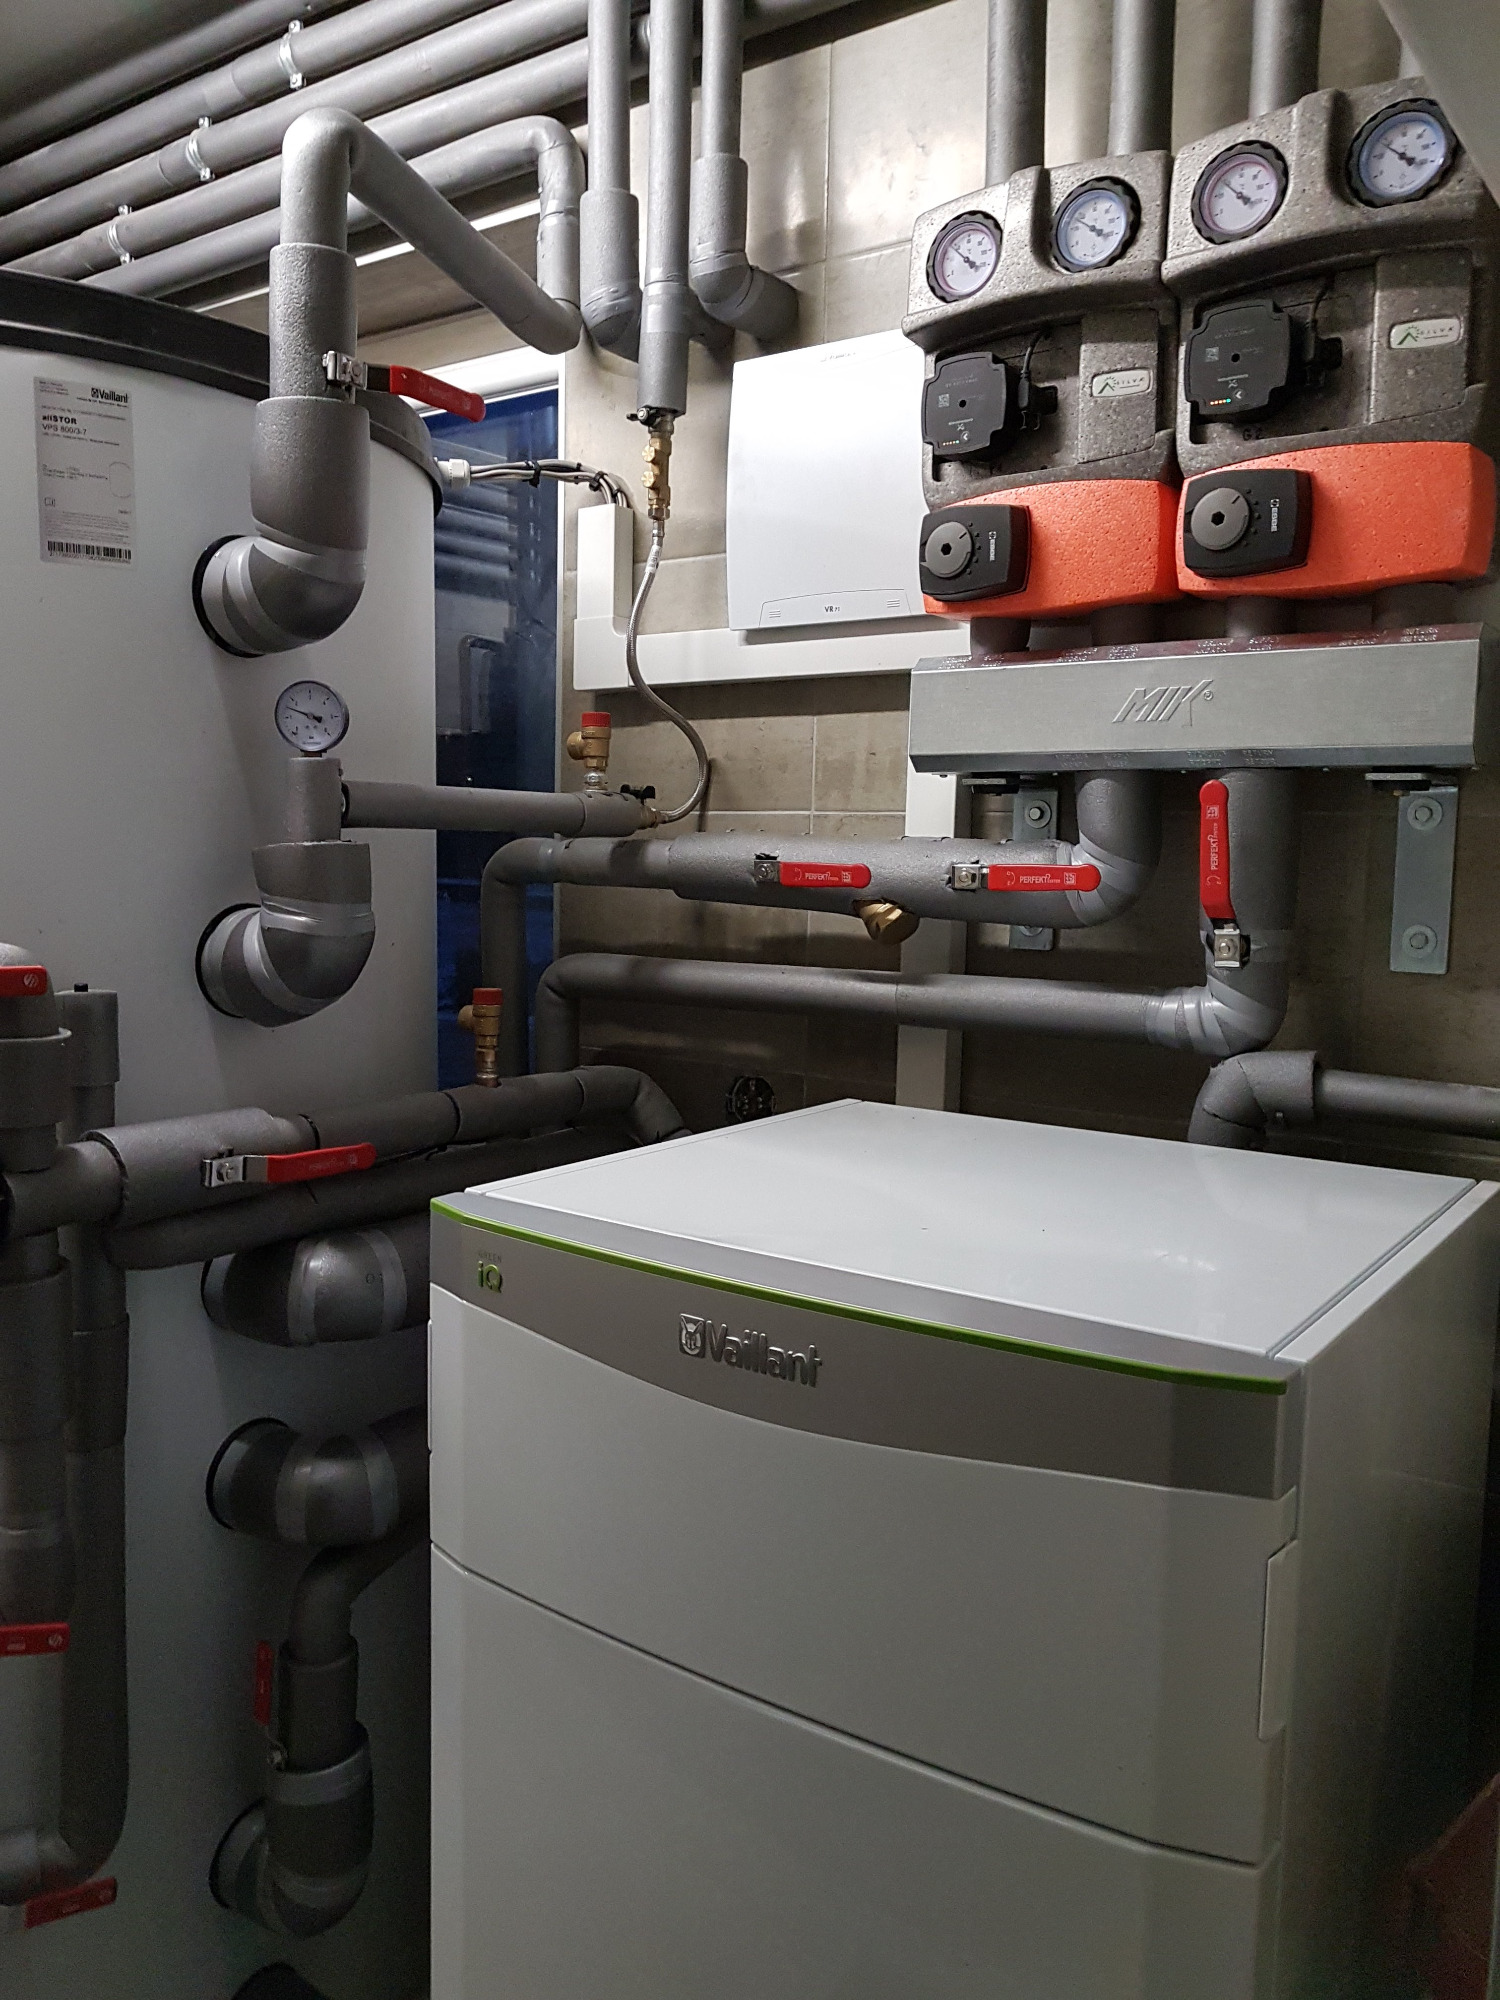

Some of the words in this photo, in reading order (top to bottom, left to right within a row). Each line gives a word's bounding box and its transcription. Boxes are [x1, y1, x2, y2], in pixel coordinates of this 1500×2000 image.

[99, 388, 128, 403] Vaillant
[42, 413, 77, 425] allSTOR
[42, 423, 58, 432] VPS
[824, 605, 834, 613] VR
[1208, 835, 1219, 871] PERFEKT
[804, 871, 831, 881] PERFEKT
[1019, 873, 1051, 884] PERFEKT
[477, 1260, 503, 1293] iQ
[705, 1319, 823, 1388] Vaillant
